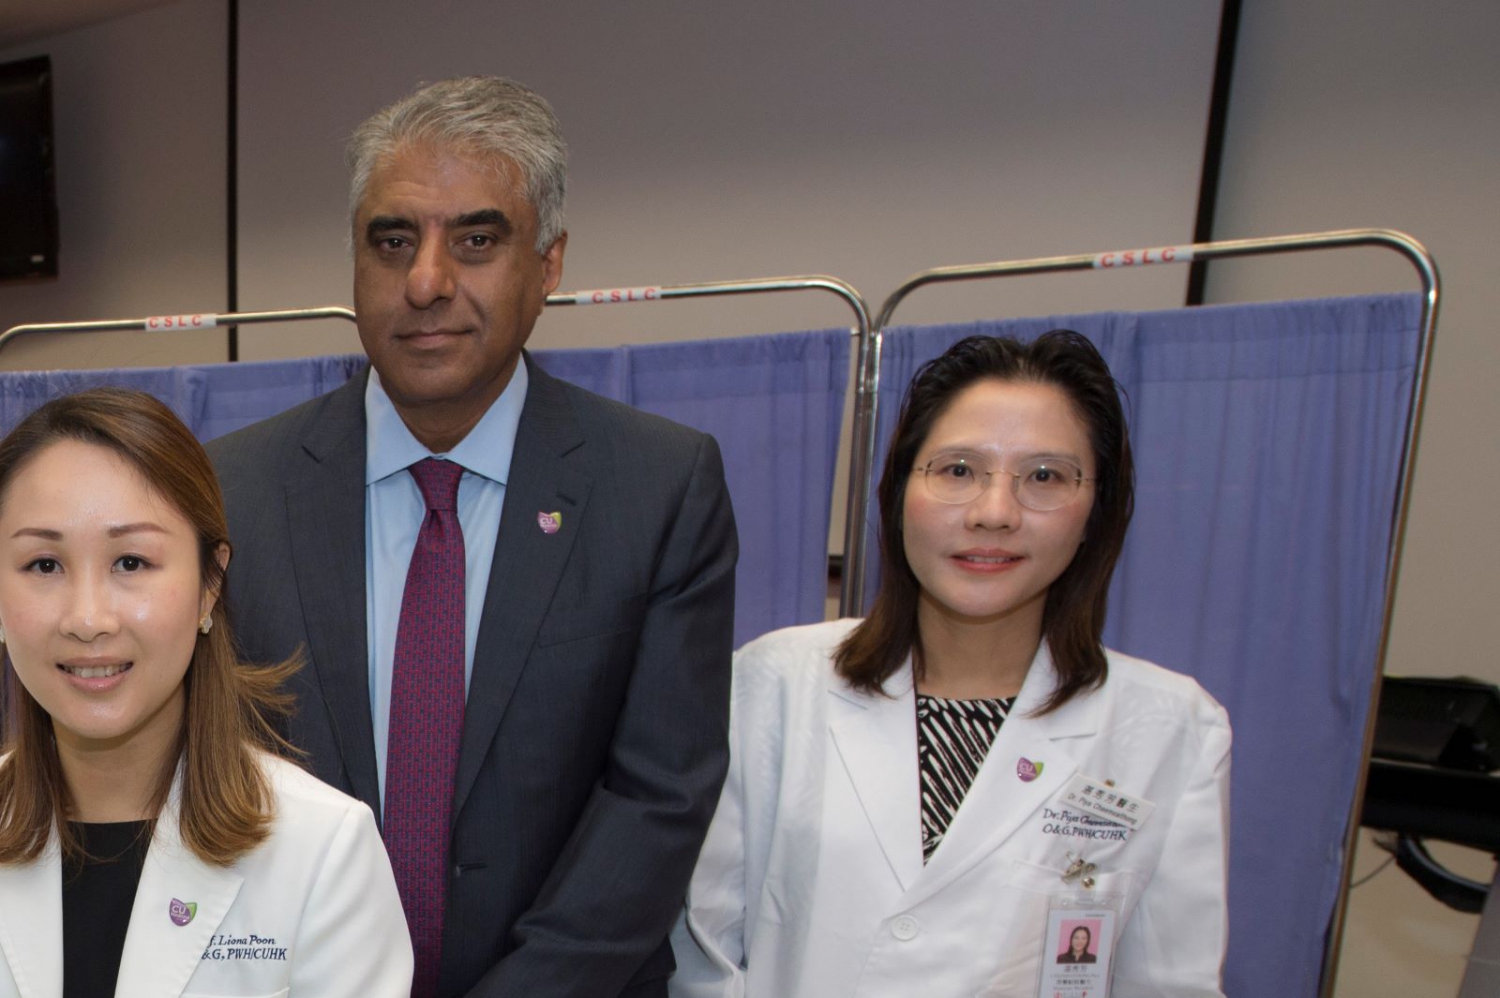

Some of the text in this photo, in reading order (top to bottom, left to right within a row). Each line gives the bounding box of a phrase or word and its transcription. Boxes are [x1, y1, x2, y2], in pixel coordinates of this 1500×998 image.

[1101, 247, 1176, 269] CSLC
[592, 288, 656, 304] CSLC
[149, 314, 202, 328] CSLC
[218, 934, 247, 945] Liona
[249, 934, 276, 945] Poon
[227, 948, 288, 961] PWH/CUHK
